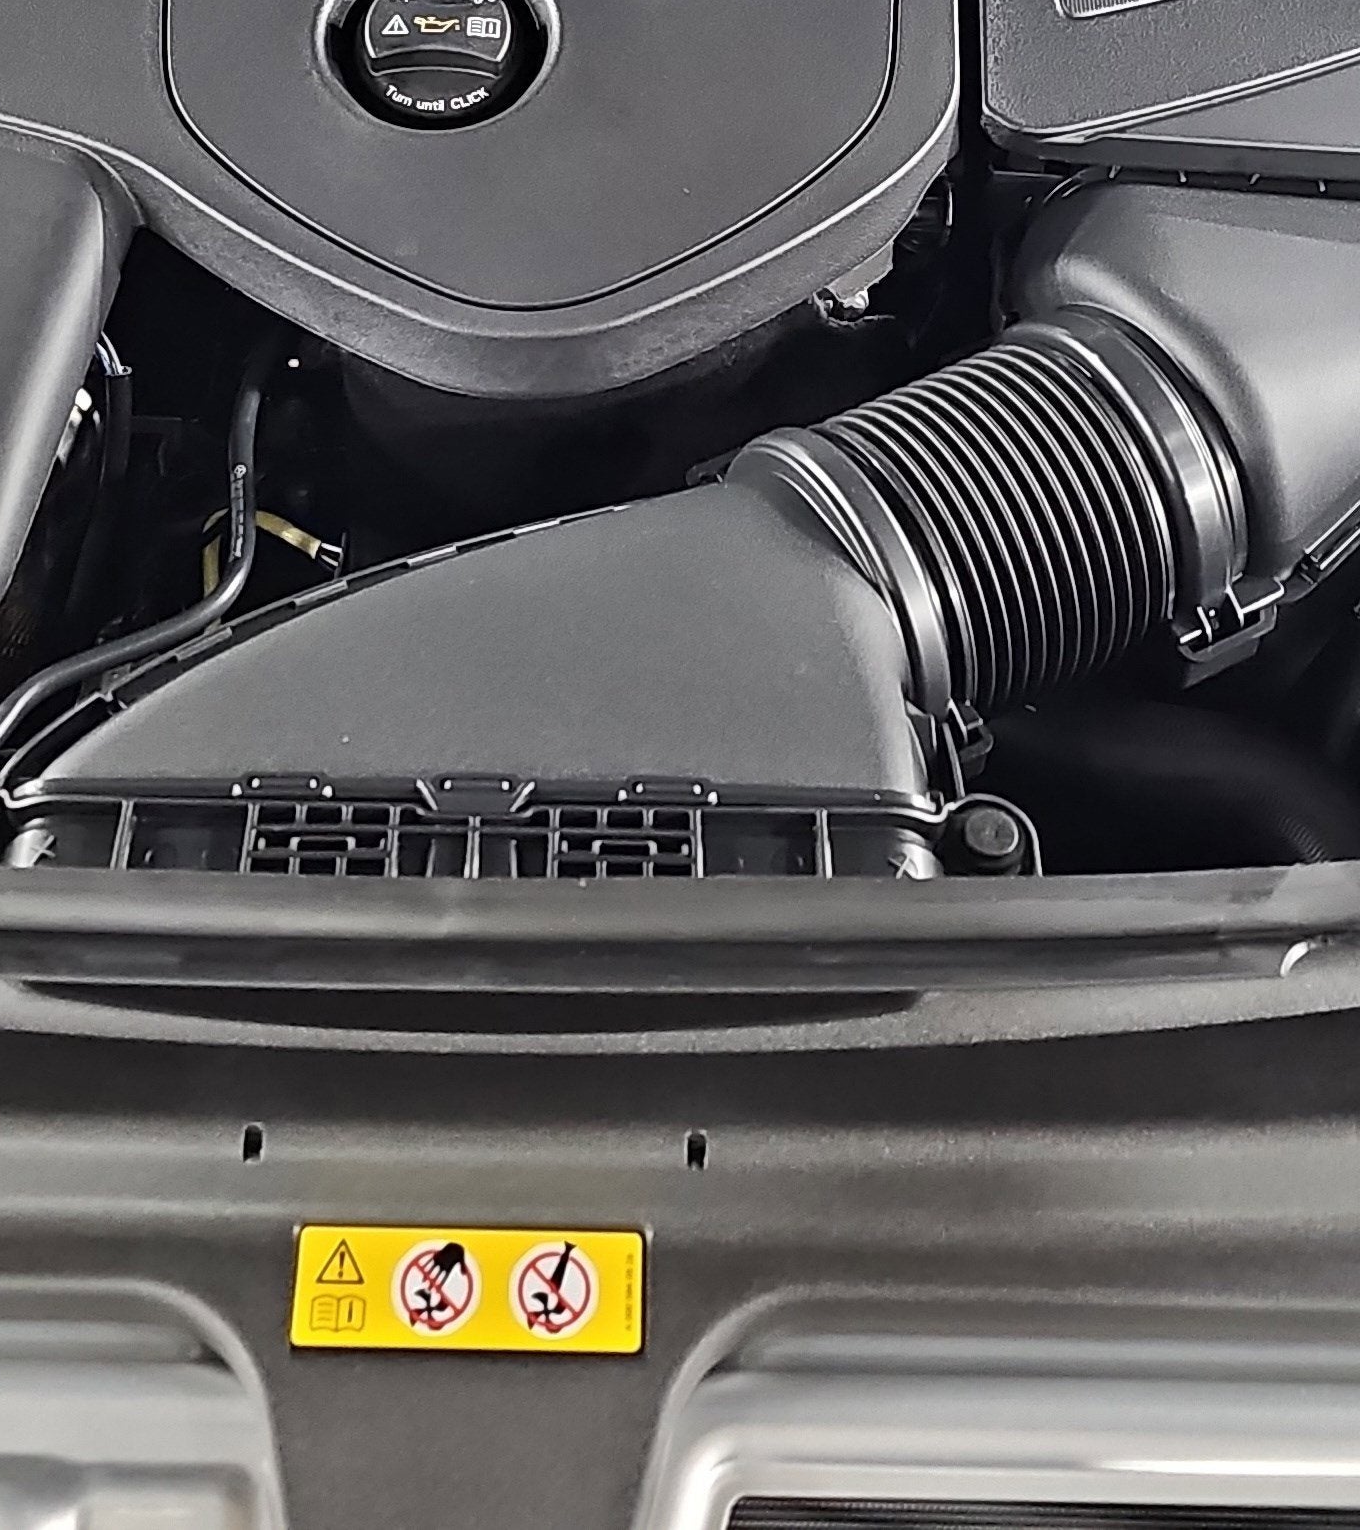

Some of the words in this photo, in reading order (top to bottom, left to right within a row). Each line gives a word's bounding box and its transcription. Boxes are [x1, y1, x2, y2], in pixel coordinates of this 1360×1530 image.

[385, 84, 413, 107] Turn
[416, 99, 445, 112] until
[450, 86, 490, 110] CLICK
